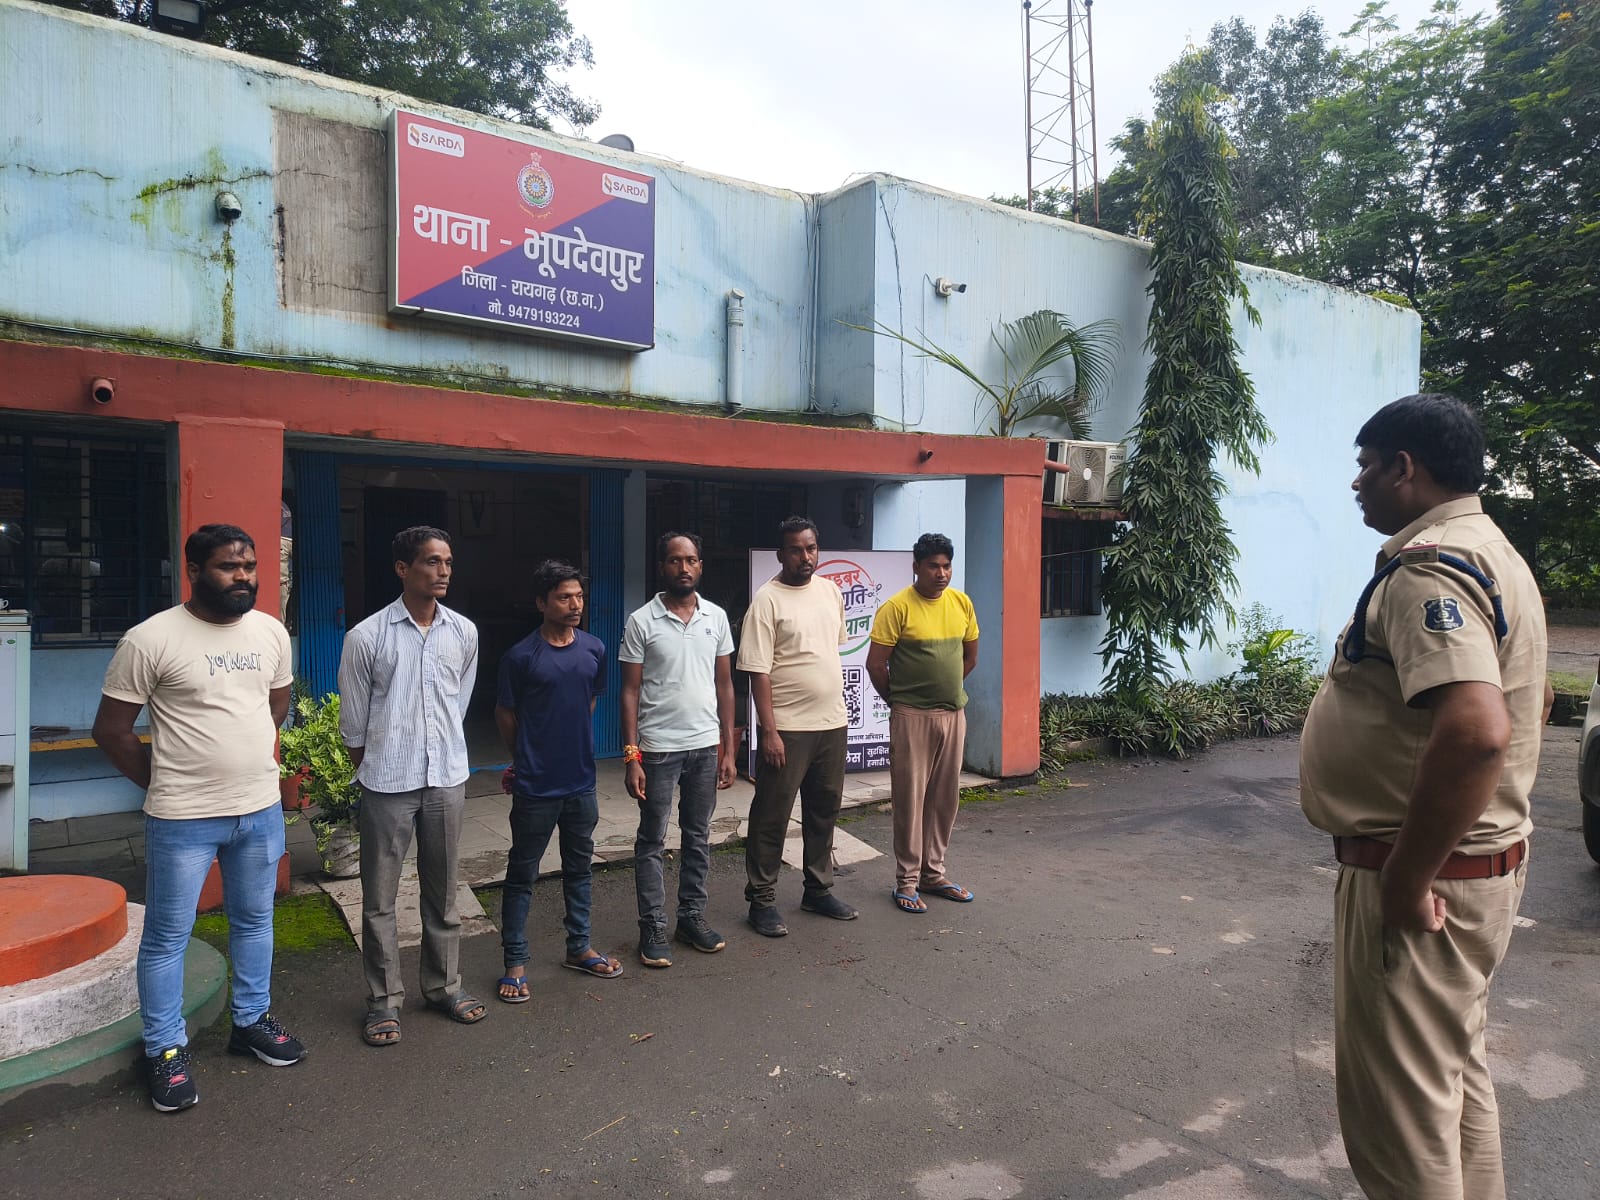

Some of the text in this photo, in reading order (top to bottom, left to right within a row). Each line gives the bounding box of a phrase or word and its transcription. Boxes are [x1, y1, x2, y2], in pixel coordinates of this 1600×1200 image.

[421, 131, 462, 151] SARDA
[613, 182, 647, 199] SARDA
[413, 204, 490, 252] थाना
[523, 226, 645, 292] भूपदेवपुर
[461, 265, 497, 291] जिला
[511, 279, 557, 305] रायगढ़
[560, 287, 605, 312] (छ.ग.)
[488, 298, 581, 328] मो. 9479193224
[820, 569, 863, 588] इबर
[841, 584, 869, 610] गृति
[845, 614, 873, 635] यान
